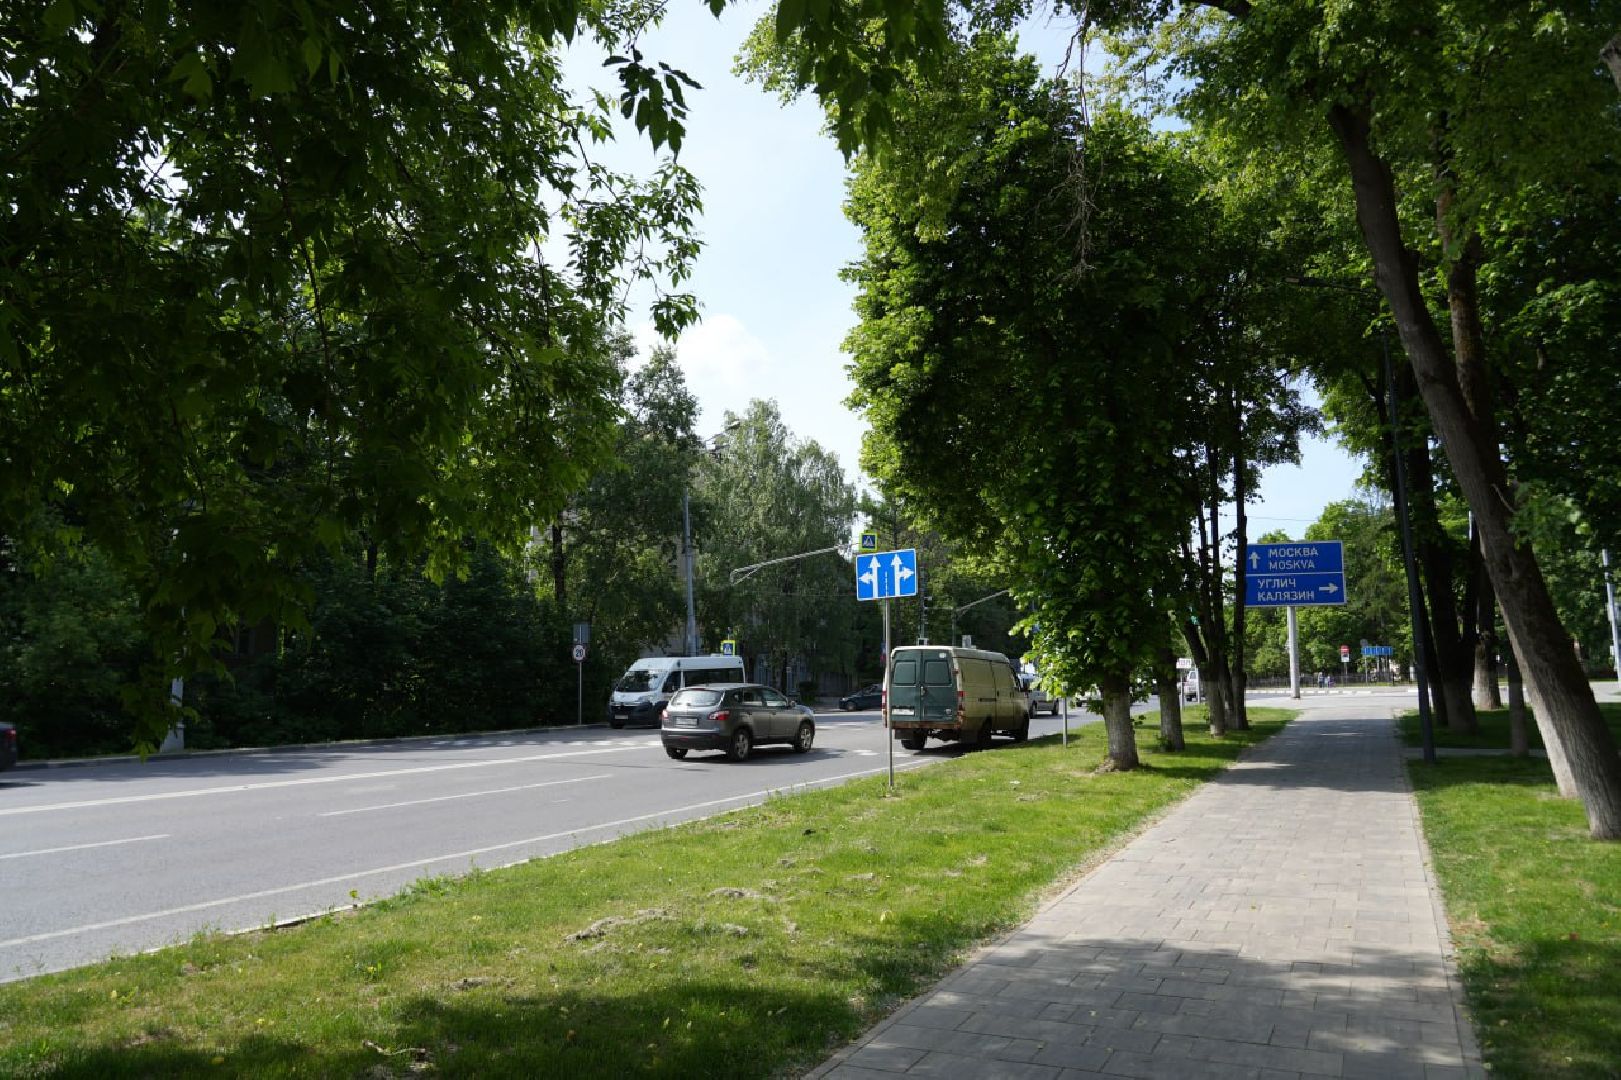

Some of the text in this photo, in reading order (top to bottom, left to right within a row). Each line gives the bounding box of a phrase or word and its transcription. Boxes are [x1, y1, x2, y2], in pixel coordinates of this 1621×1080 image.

[1269, 547, 1319, 558] МОСКВА
[1269, 559, 1316, 570] MOSKVA
[1257, 578, 1296, 589] УГЛИЧ
[1257, 591, 1315, 602] КАЛЯЗИН
